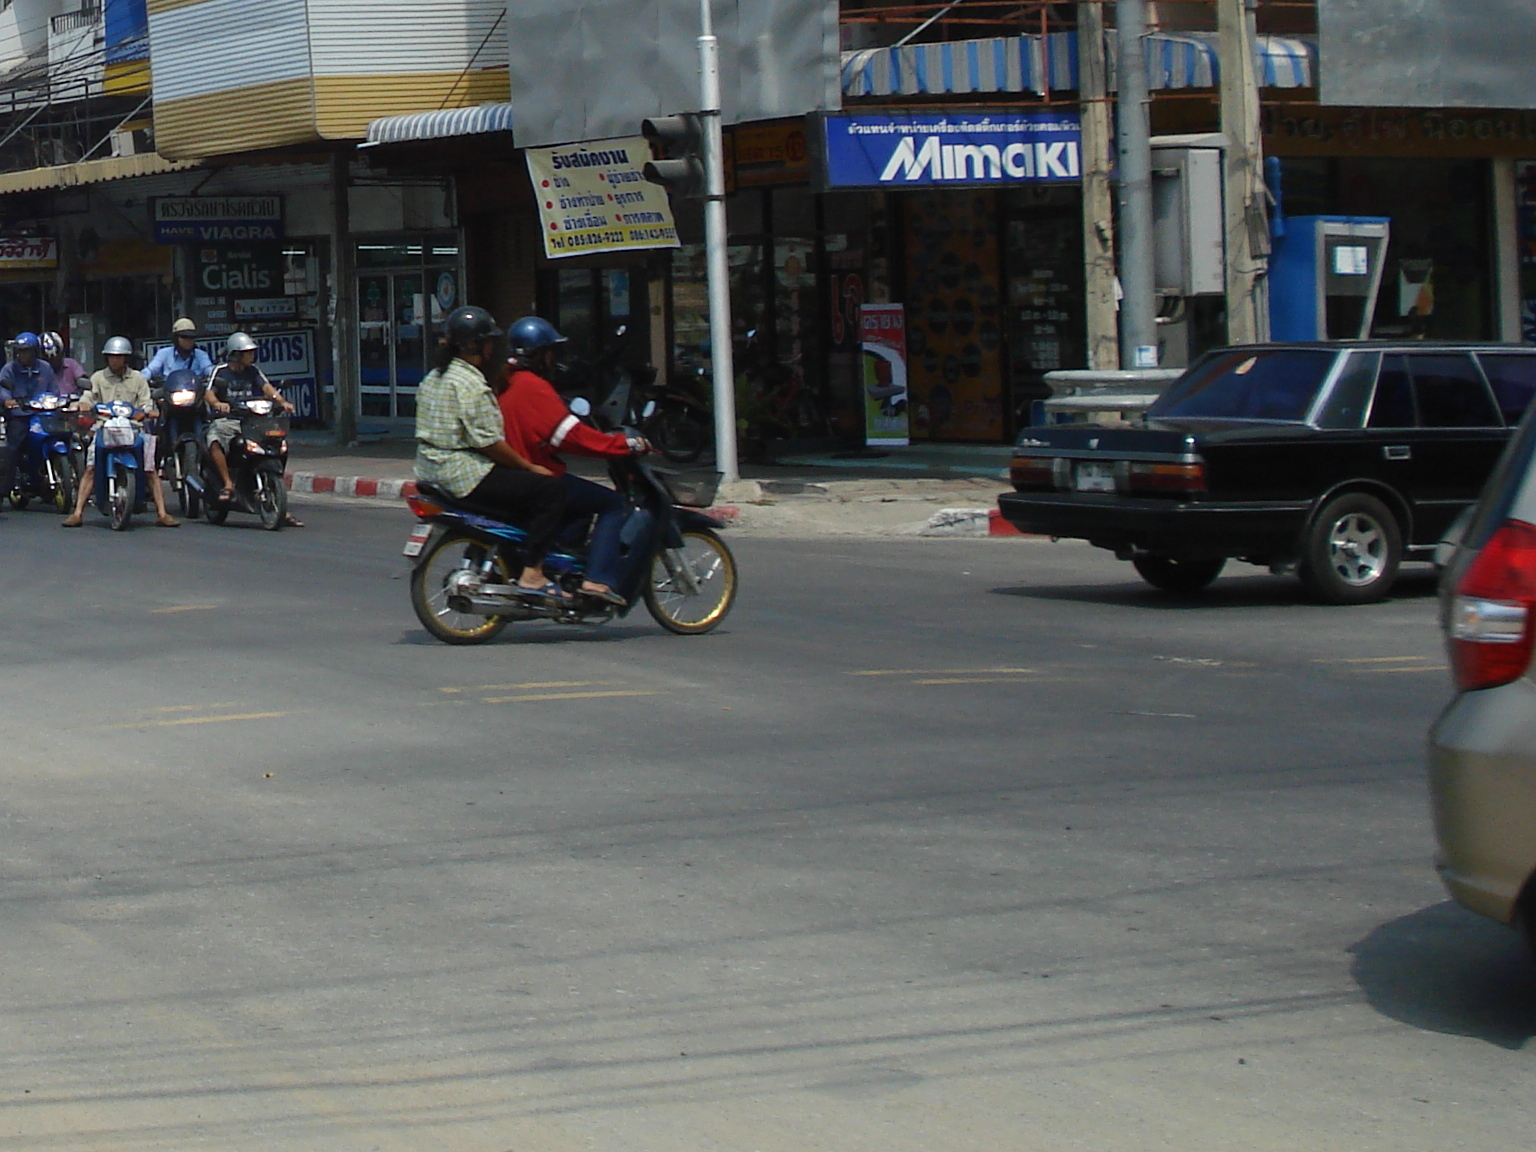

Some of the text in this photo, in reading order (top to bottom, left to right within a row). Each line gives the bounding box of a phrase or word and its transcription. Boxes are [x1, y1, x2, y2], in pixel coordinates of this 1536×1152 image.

[606, 167, 646, 189] ผู้ช่วยช่า
[161, 225, 277, 240] HAVE VIAGRA
[551, 236, 565, 249] Tel
[202, 263, 271, 290] Cialis
